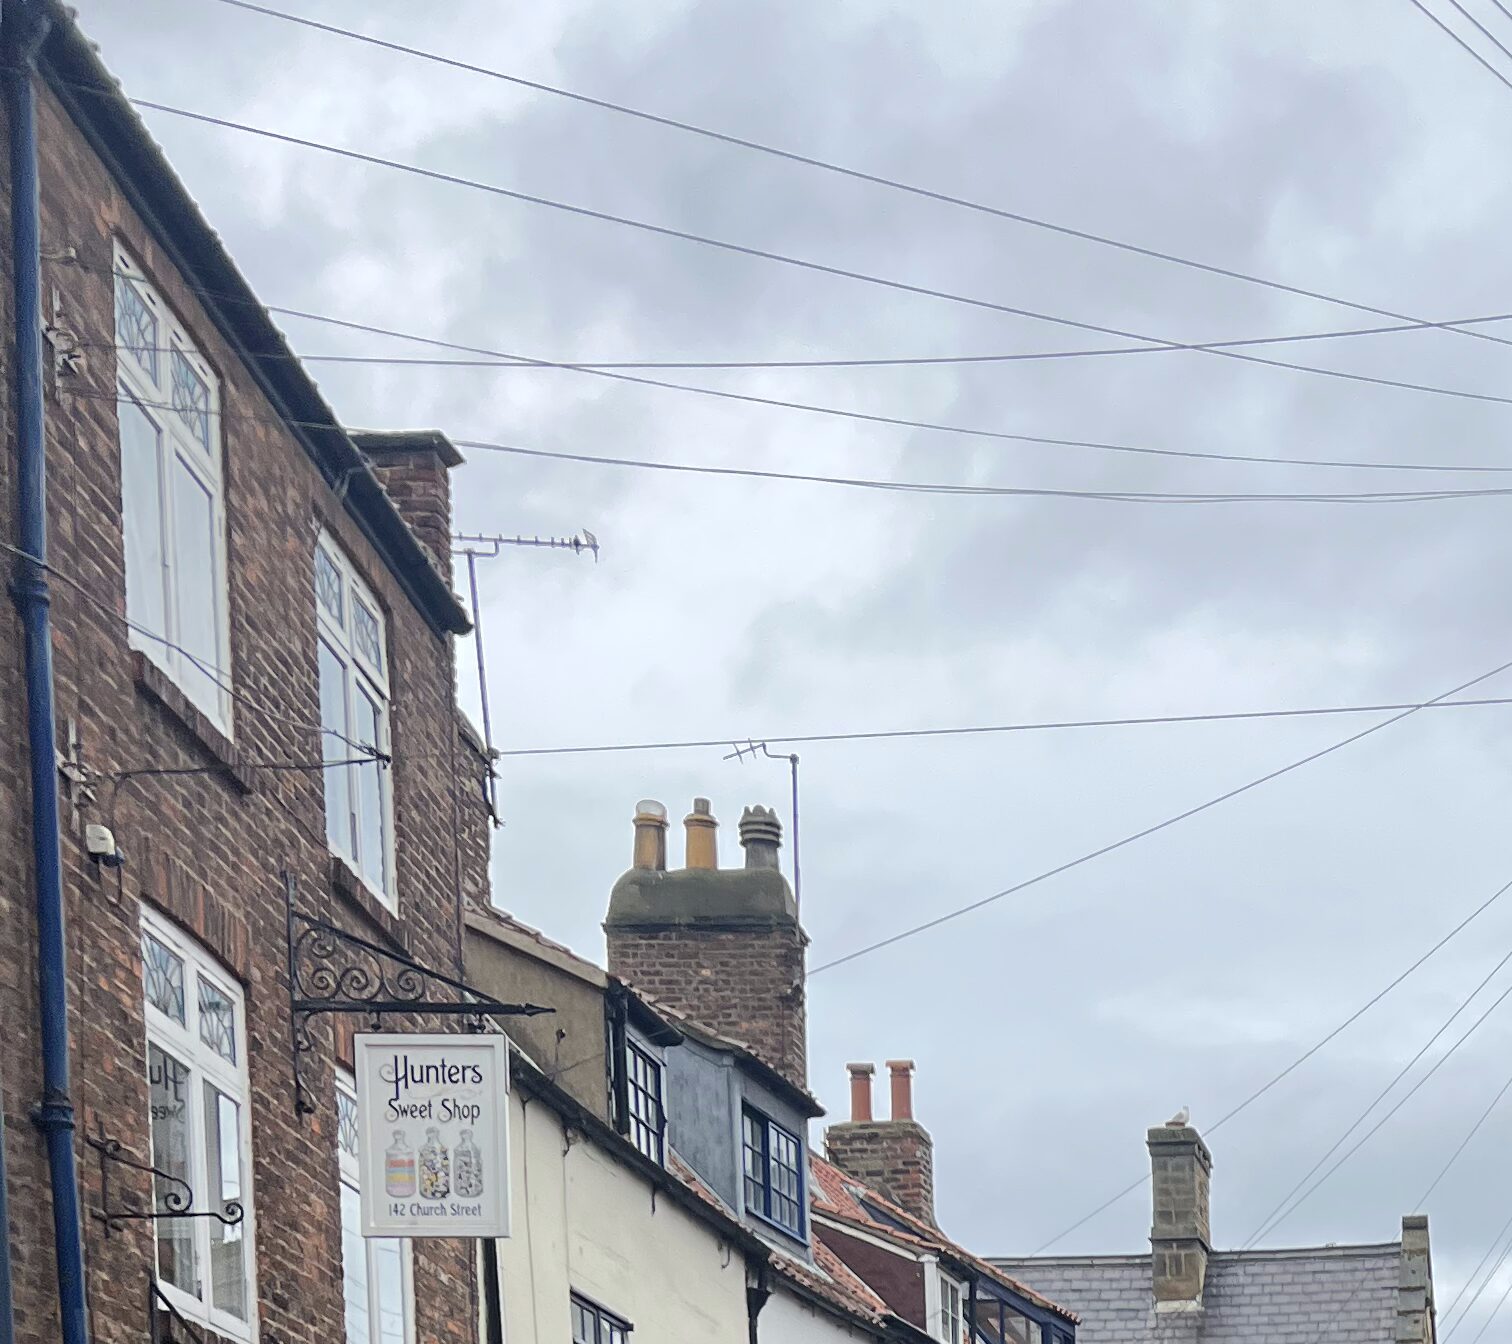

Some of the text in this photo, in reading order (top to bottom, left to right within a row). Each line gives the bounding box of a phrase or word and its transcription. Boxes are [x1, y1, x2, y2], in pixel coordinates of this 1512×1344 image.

[379, 1055, 483, 1100] Hunters
[385, 1098, 480, 1125] Sweet Shop
[388, 1202, 482, 1217] 142 Church Street
